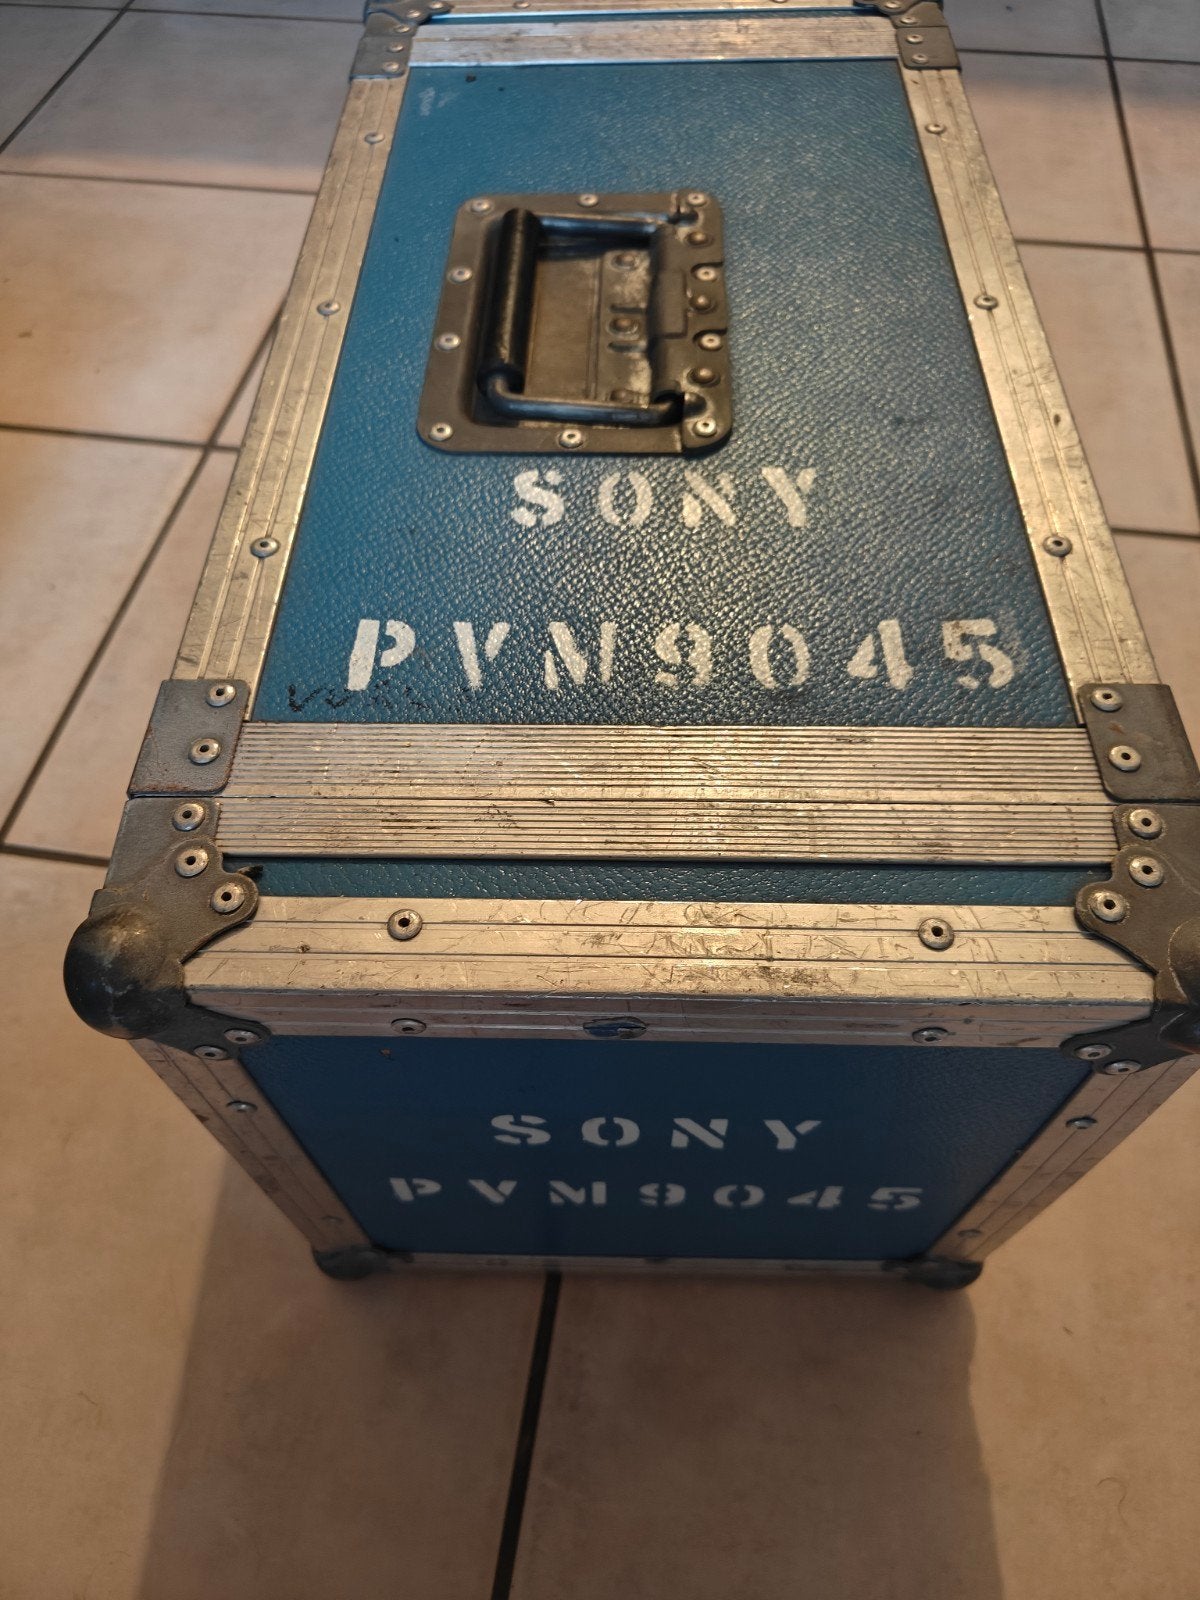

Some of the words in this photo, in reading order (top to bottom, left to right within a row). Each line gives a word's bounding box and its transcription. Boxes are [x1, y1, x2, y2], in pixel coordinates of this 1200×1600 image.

[509, 466, 818, 528] SONY
[490, 1114, 822, 1150] SONY
[389, 1177, 924, 1210] PVM9045
